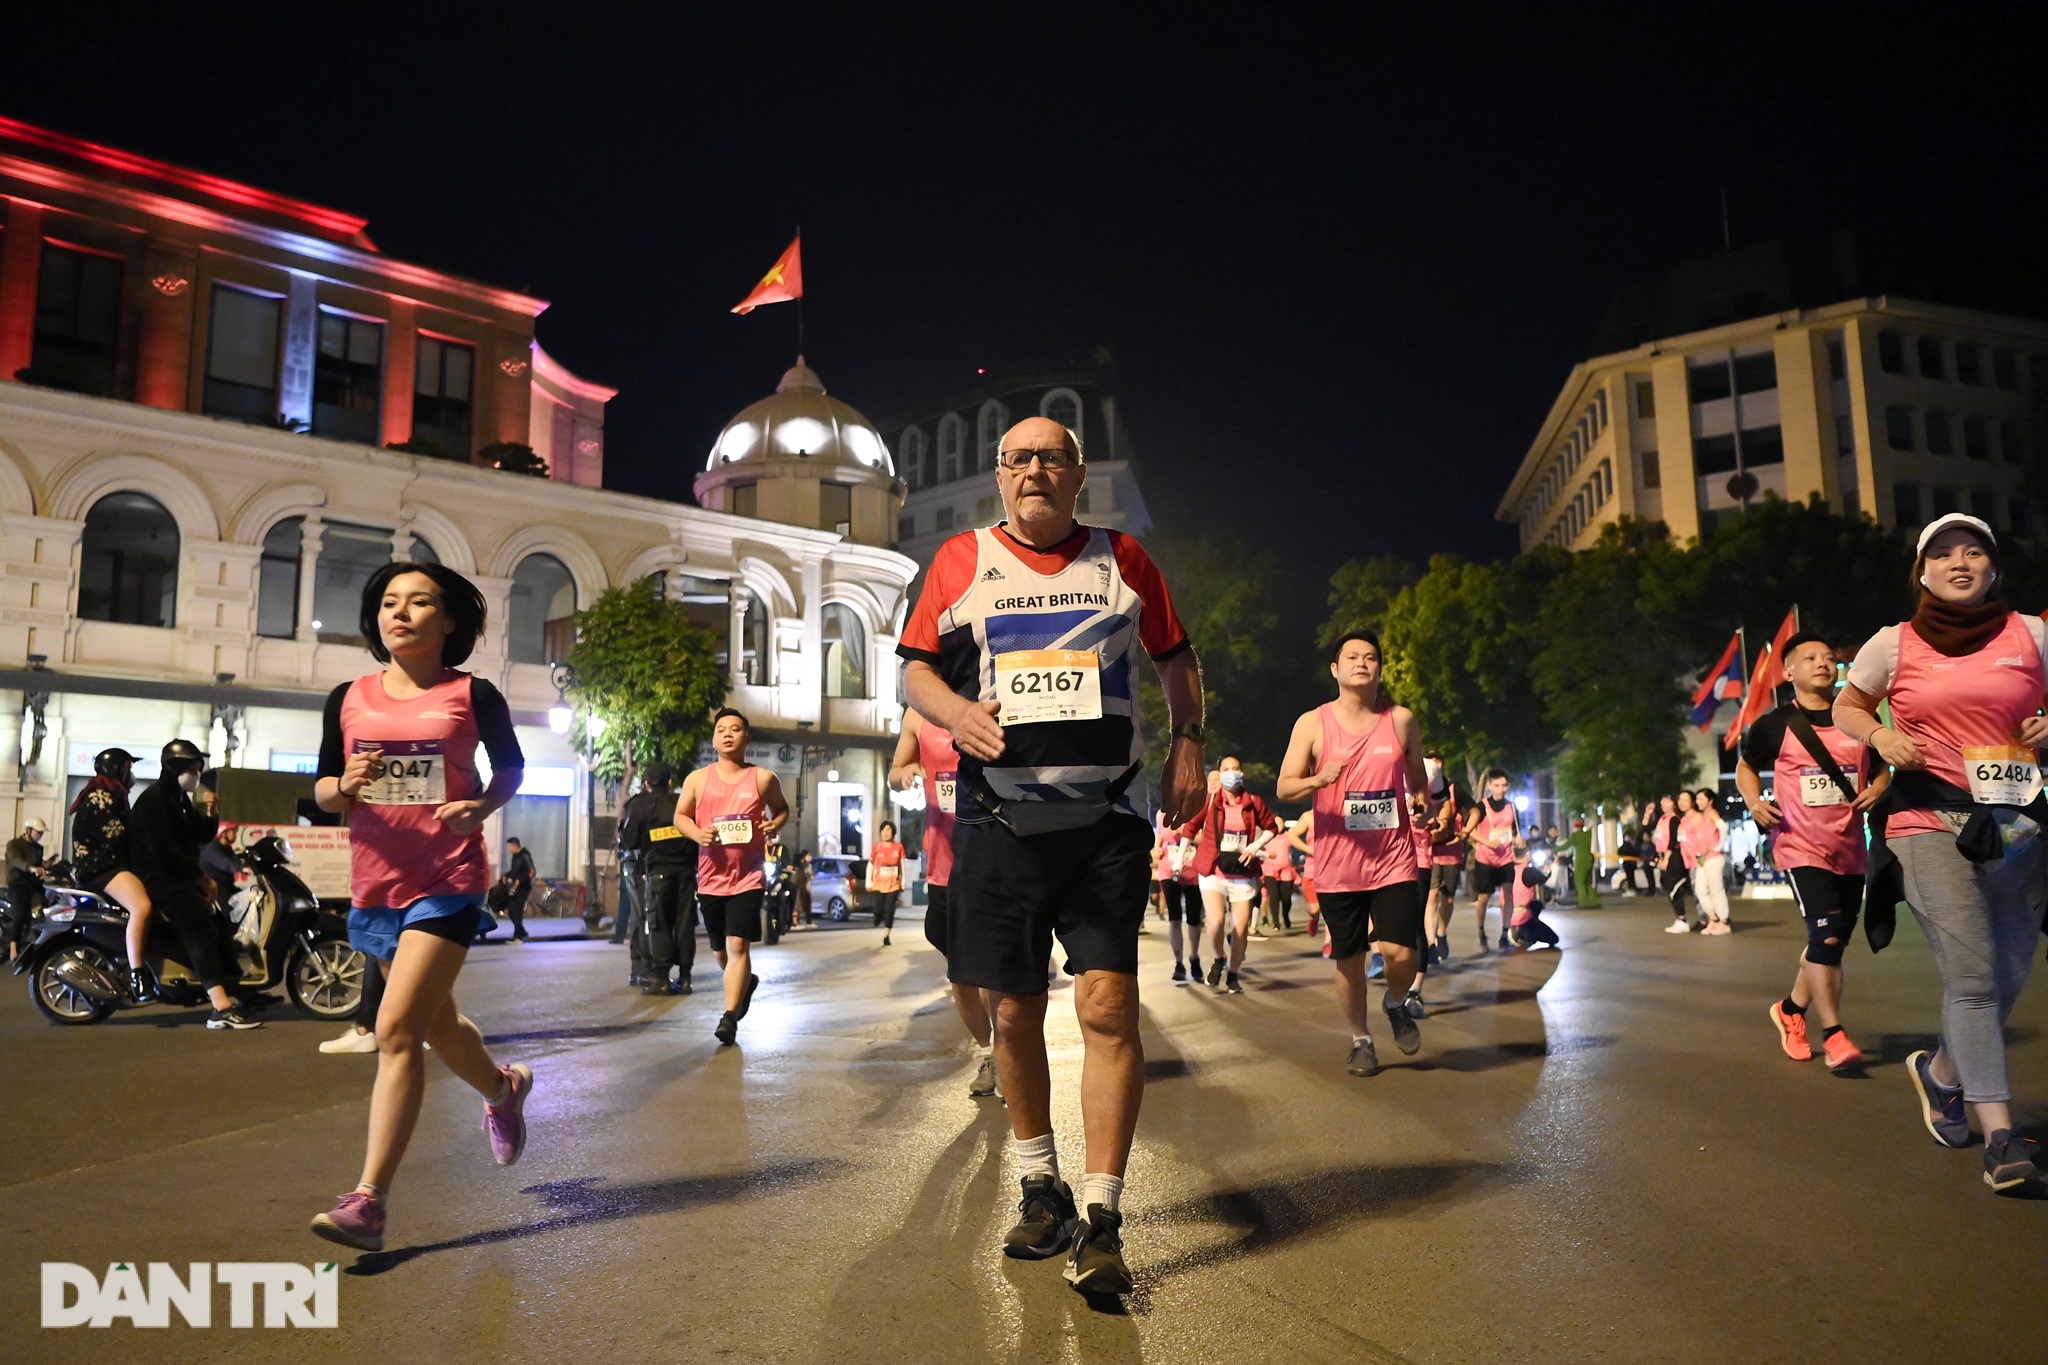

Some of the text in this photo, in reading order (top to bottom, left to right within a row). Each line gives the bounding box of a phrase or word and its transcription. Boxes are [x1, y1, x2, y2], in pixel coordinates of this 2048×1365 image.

[981, 574, 1005, 582] adidas
[994, 592, 1109, 610] GREAT BRITAIN
[1010, 671, 1084, 695] 62167
[1976, 764, 2033, 784] 62484
[1350, 801, 1392, 815] 84093
